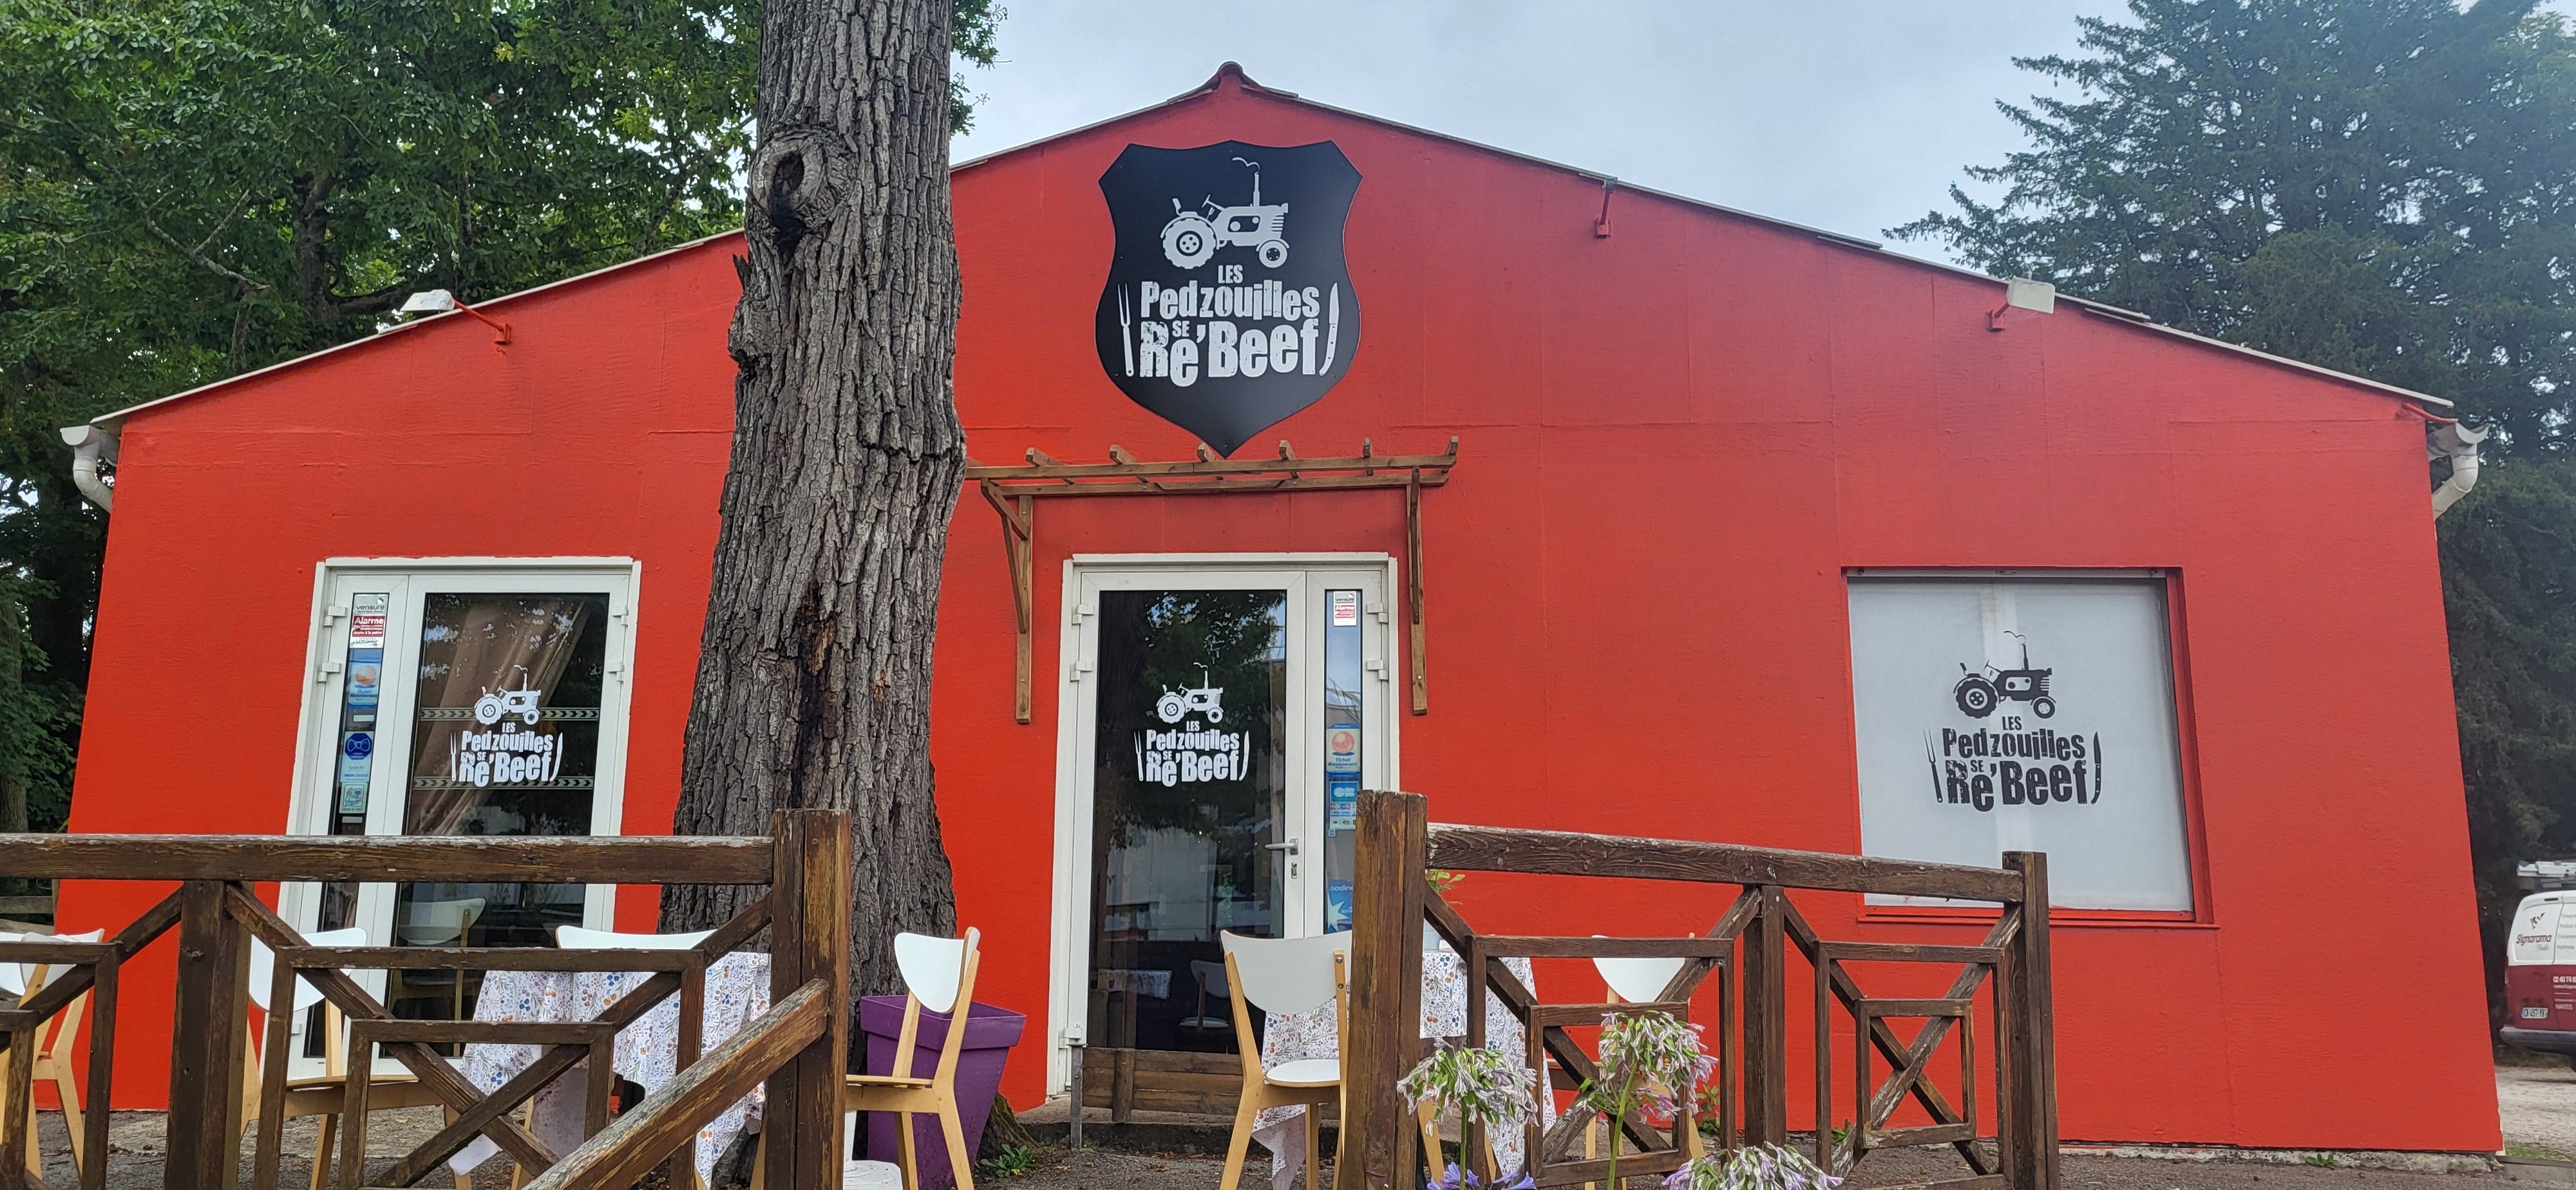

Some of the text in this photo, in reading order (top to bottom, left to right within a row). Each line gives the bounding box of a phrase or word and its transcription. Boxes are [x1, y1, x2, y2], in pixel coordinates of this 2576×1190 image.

[1218, 265, 1243, 283] LES
[1141, 279, 1320, 321] Pedzouilles
[1172, 320, 1189, 337] SE
[502, 722, 516, 733] LES
[1186, 721, 1200, 732] LES
[2002, 716, 2022, 730] LES
[461, 730, 553, 753] Pedzouilles
[1146, 729, 1240, 751] Pedzouilles
[1942, 728, 2086, 761] Pedzouilles
[477, 751, 486, 761] SE
[1163, 751, 1172, 760] SE
[1970, 760, 1984, 772] SE
[2516, 934, 2552, 946] Signarama
